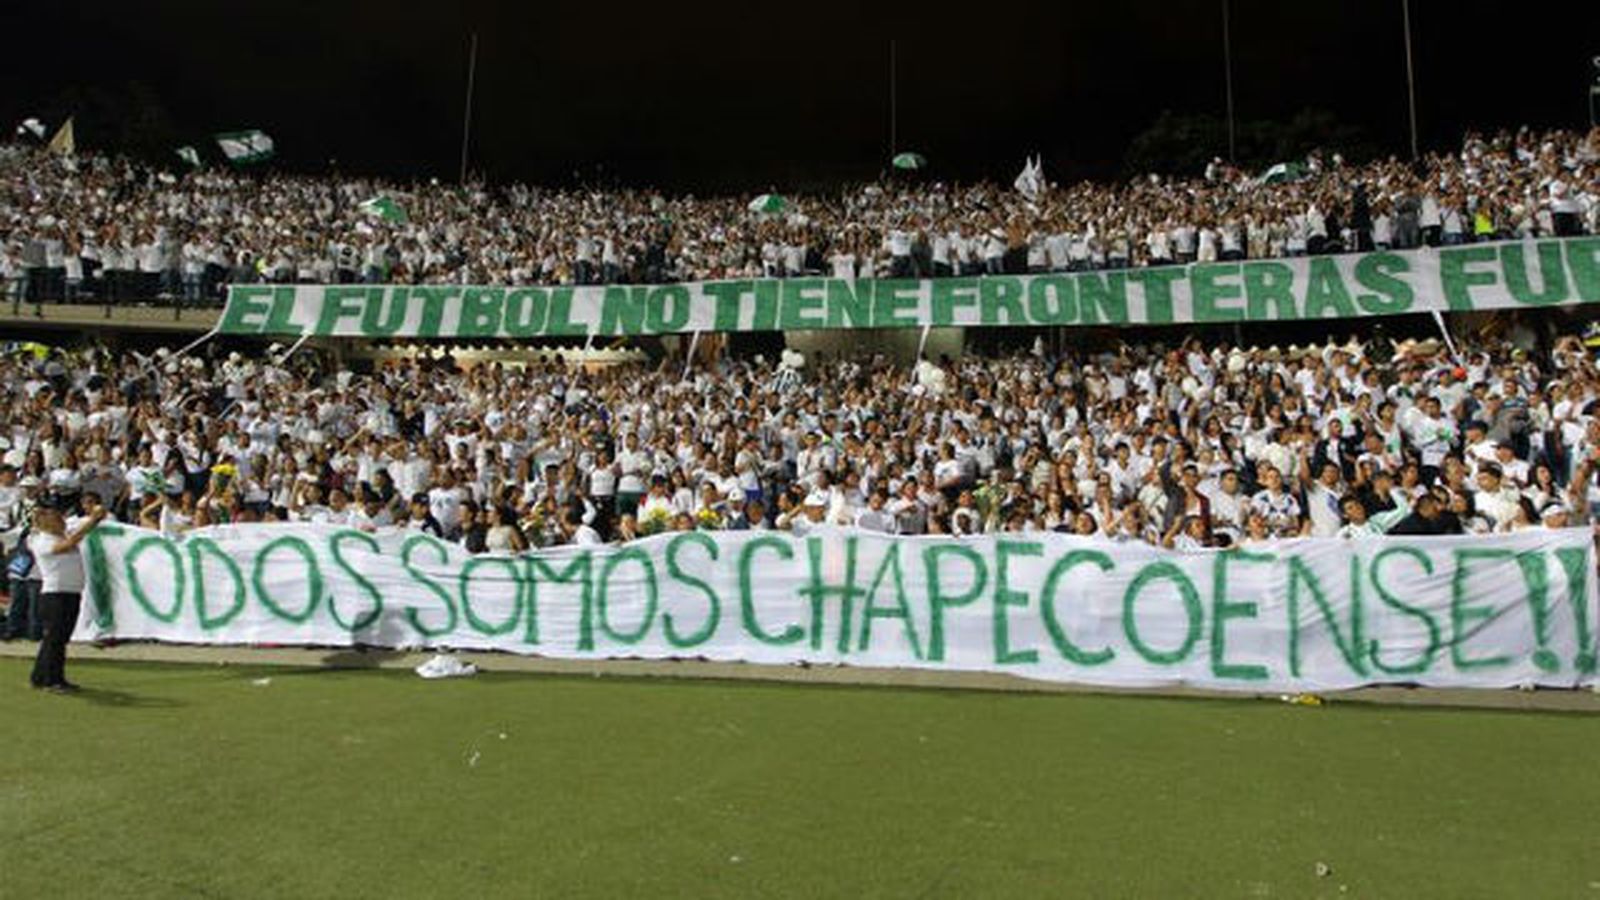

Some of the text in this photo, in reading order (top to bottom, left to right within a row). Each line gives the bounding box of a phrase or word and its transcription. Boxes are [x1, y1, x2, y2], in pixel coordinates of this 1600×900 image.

[223, 285, 311, 334] EL
[316, 285, 587, 336] FUTBOL
[601, 285, 691, 336] NO
[702, 279, 921, 331] TIENE
[930, 252, 1415, 326] FRONTERAS
[86, 525, 1593, 678] TODOS SOMOS CHAPECOENSE!!
